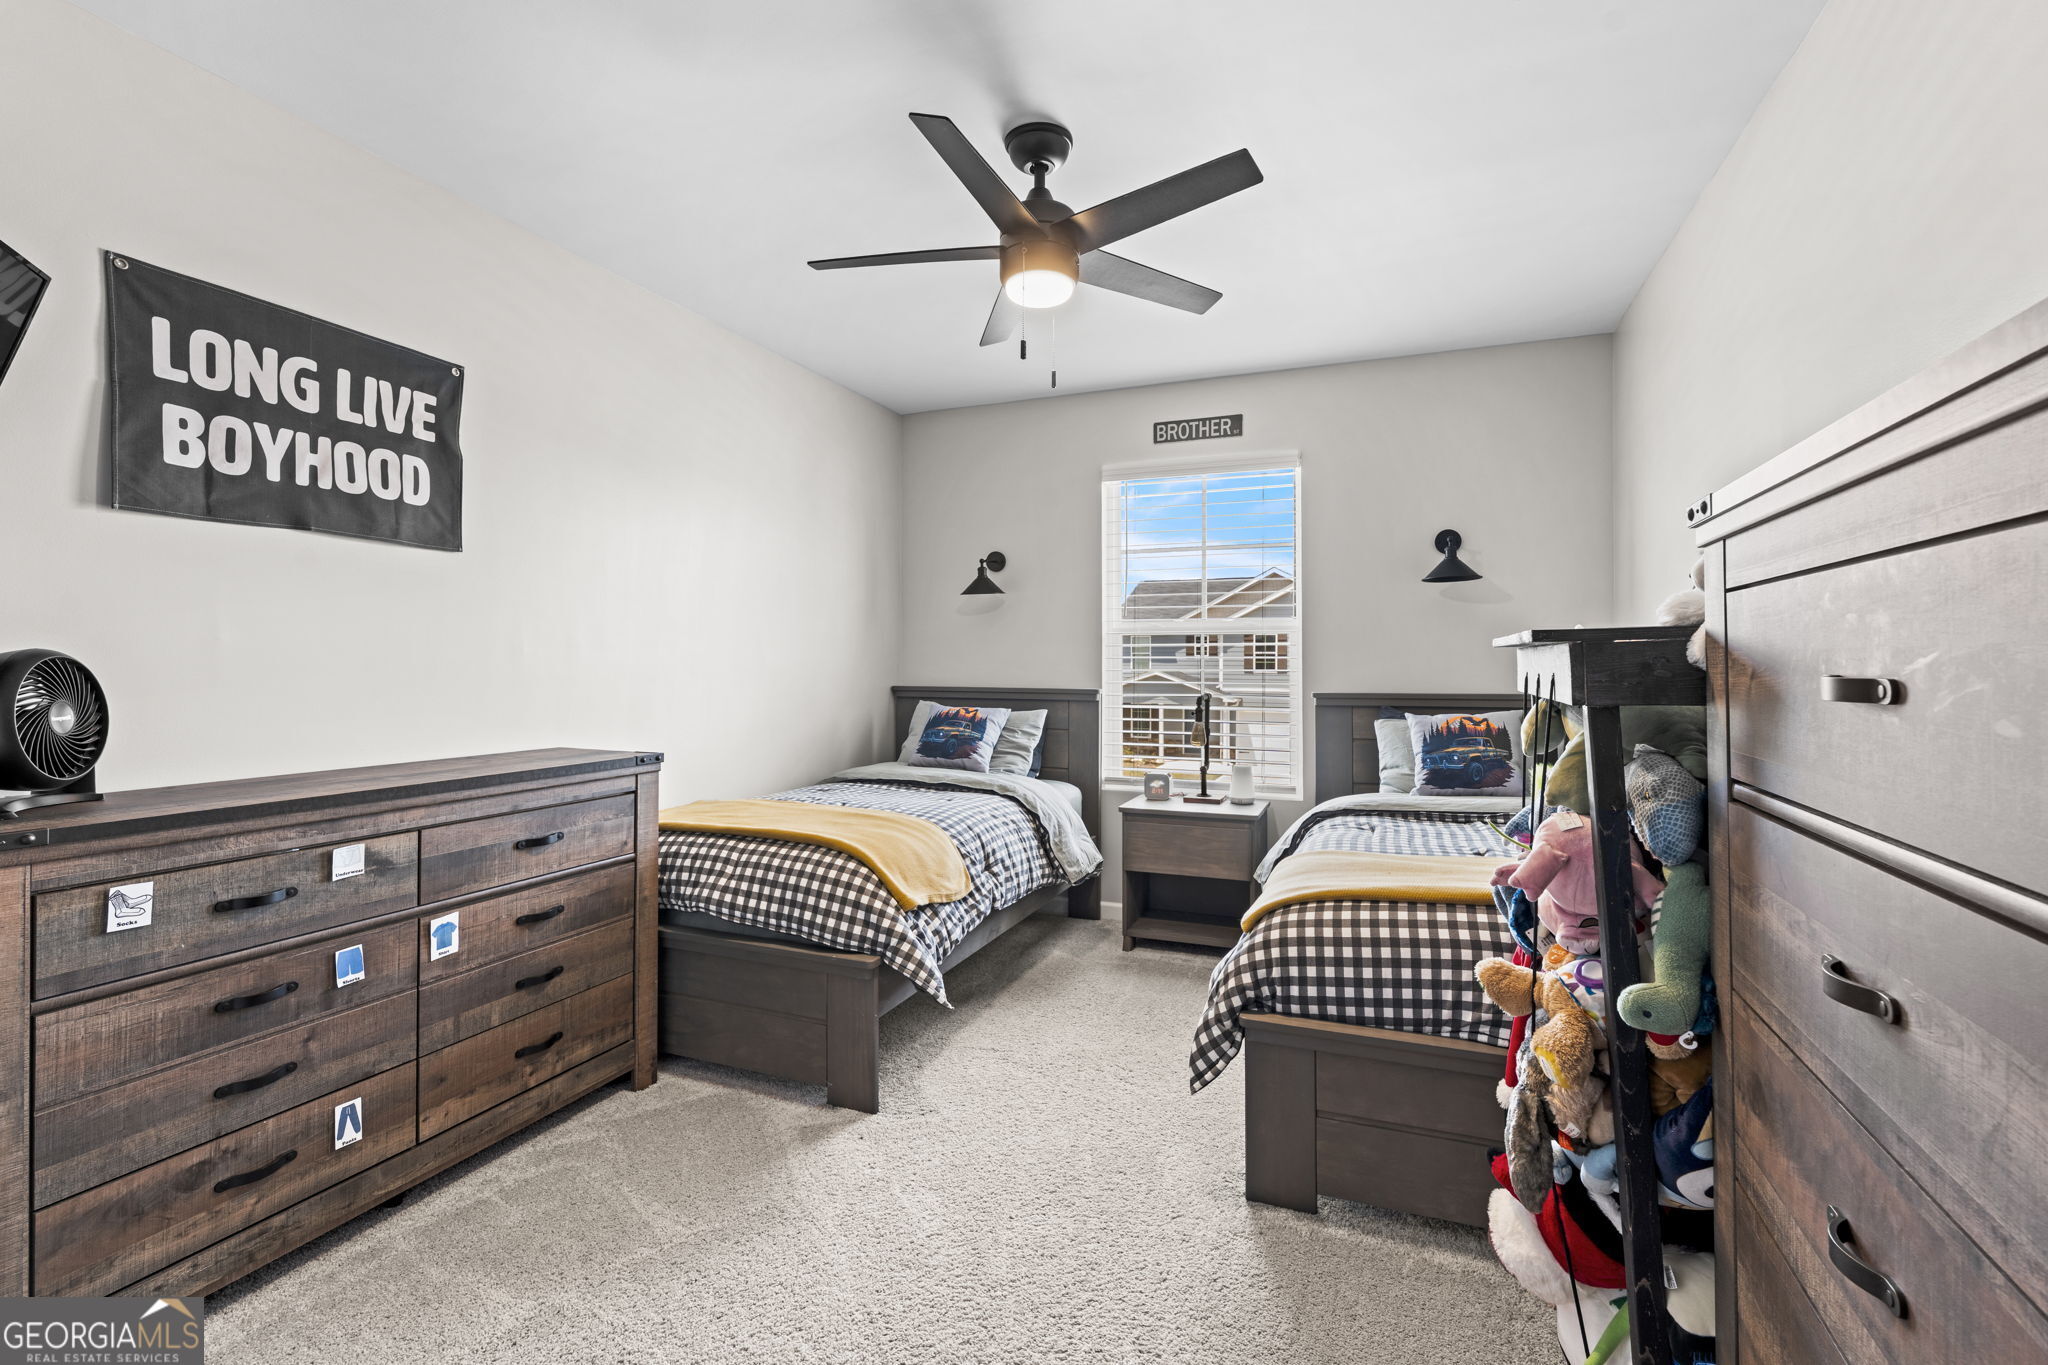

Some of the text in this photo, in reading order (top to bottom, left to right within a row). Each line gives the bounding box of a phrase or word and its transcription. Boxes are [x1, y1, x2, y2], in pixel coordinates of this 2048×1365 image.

[151, 315, 438, 443] LONG LIVE
[1156, 418, 1232, 442] BROTHER
[162, 402, 431, 506] BOYHOOD
[335, 868, 364, 878] Underwear
[116, 920, 138, 928] Socks
